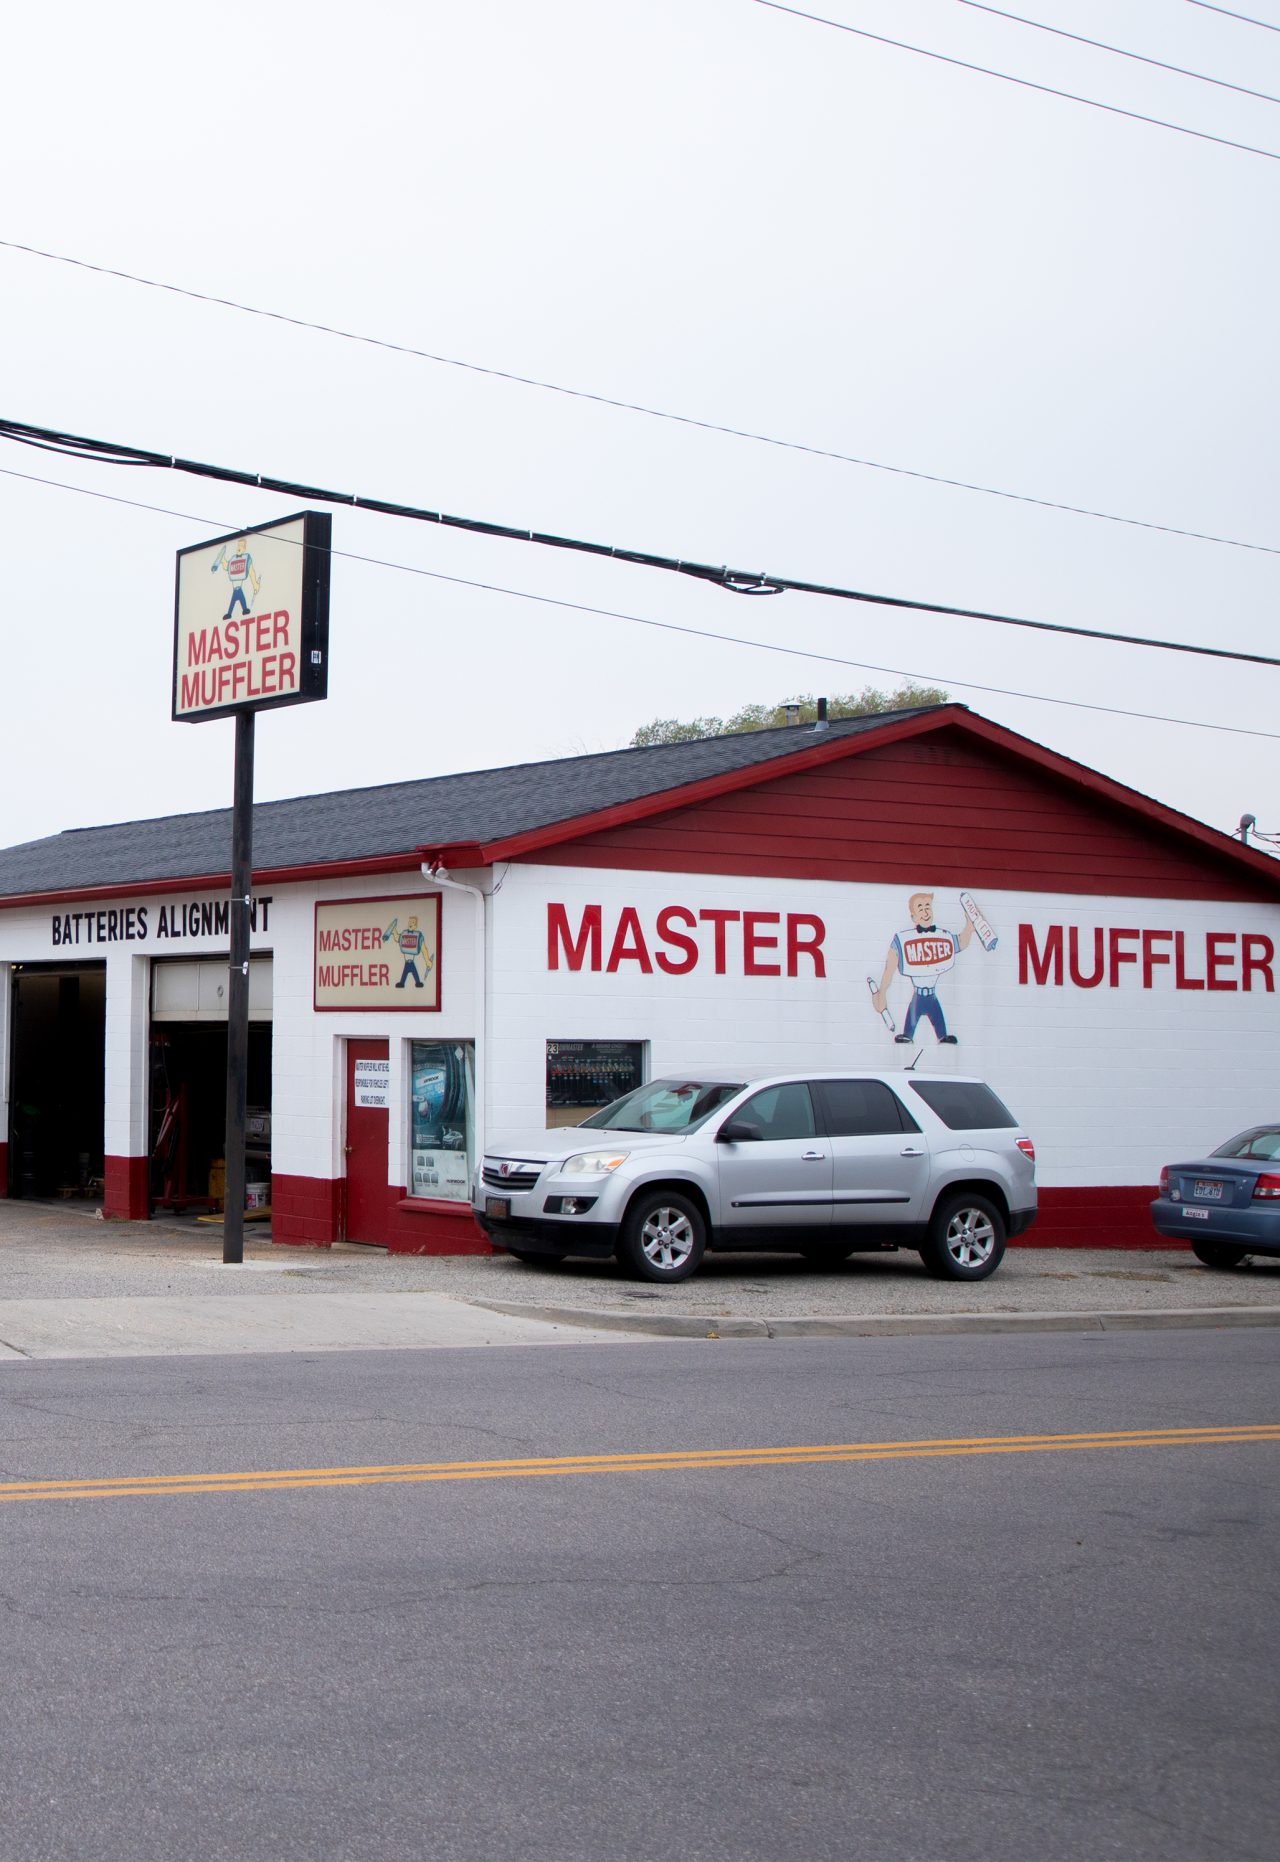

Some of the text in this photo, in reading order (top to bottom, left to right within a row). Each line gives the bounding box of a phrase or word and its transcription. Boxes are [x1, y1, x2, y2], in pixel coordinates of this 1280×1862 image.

[187, 609, 290, 667] MASTER
[181, 651, 296, 709] MUFFLER
[52, 906, 148, 946] BATTERIES
[157, 896, 273, 939] ALIGNMNT
[319, 927, 383, 952] MASTER
[547, 902, 827, 978] MASTER
[906, 941, 952, 963] MASTER
[1018, 923, 1275, 993] MUFFLER
[318, 963, 390, 988] MUFFLER
[547, 1043, 559, 1053] 23
